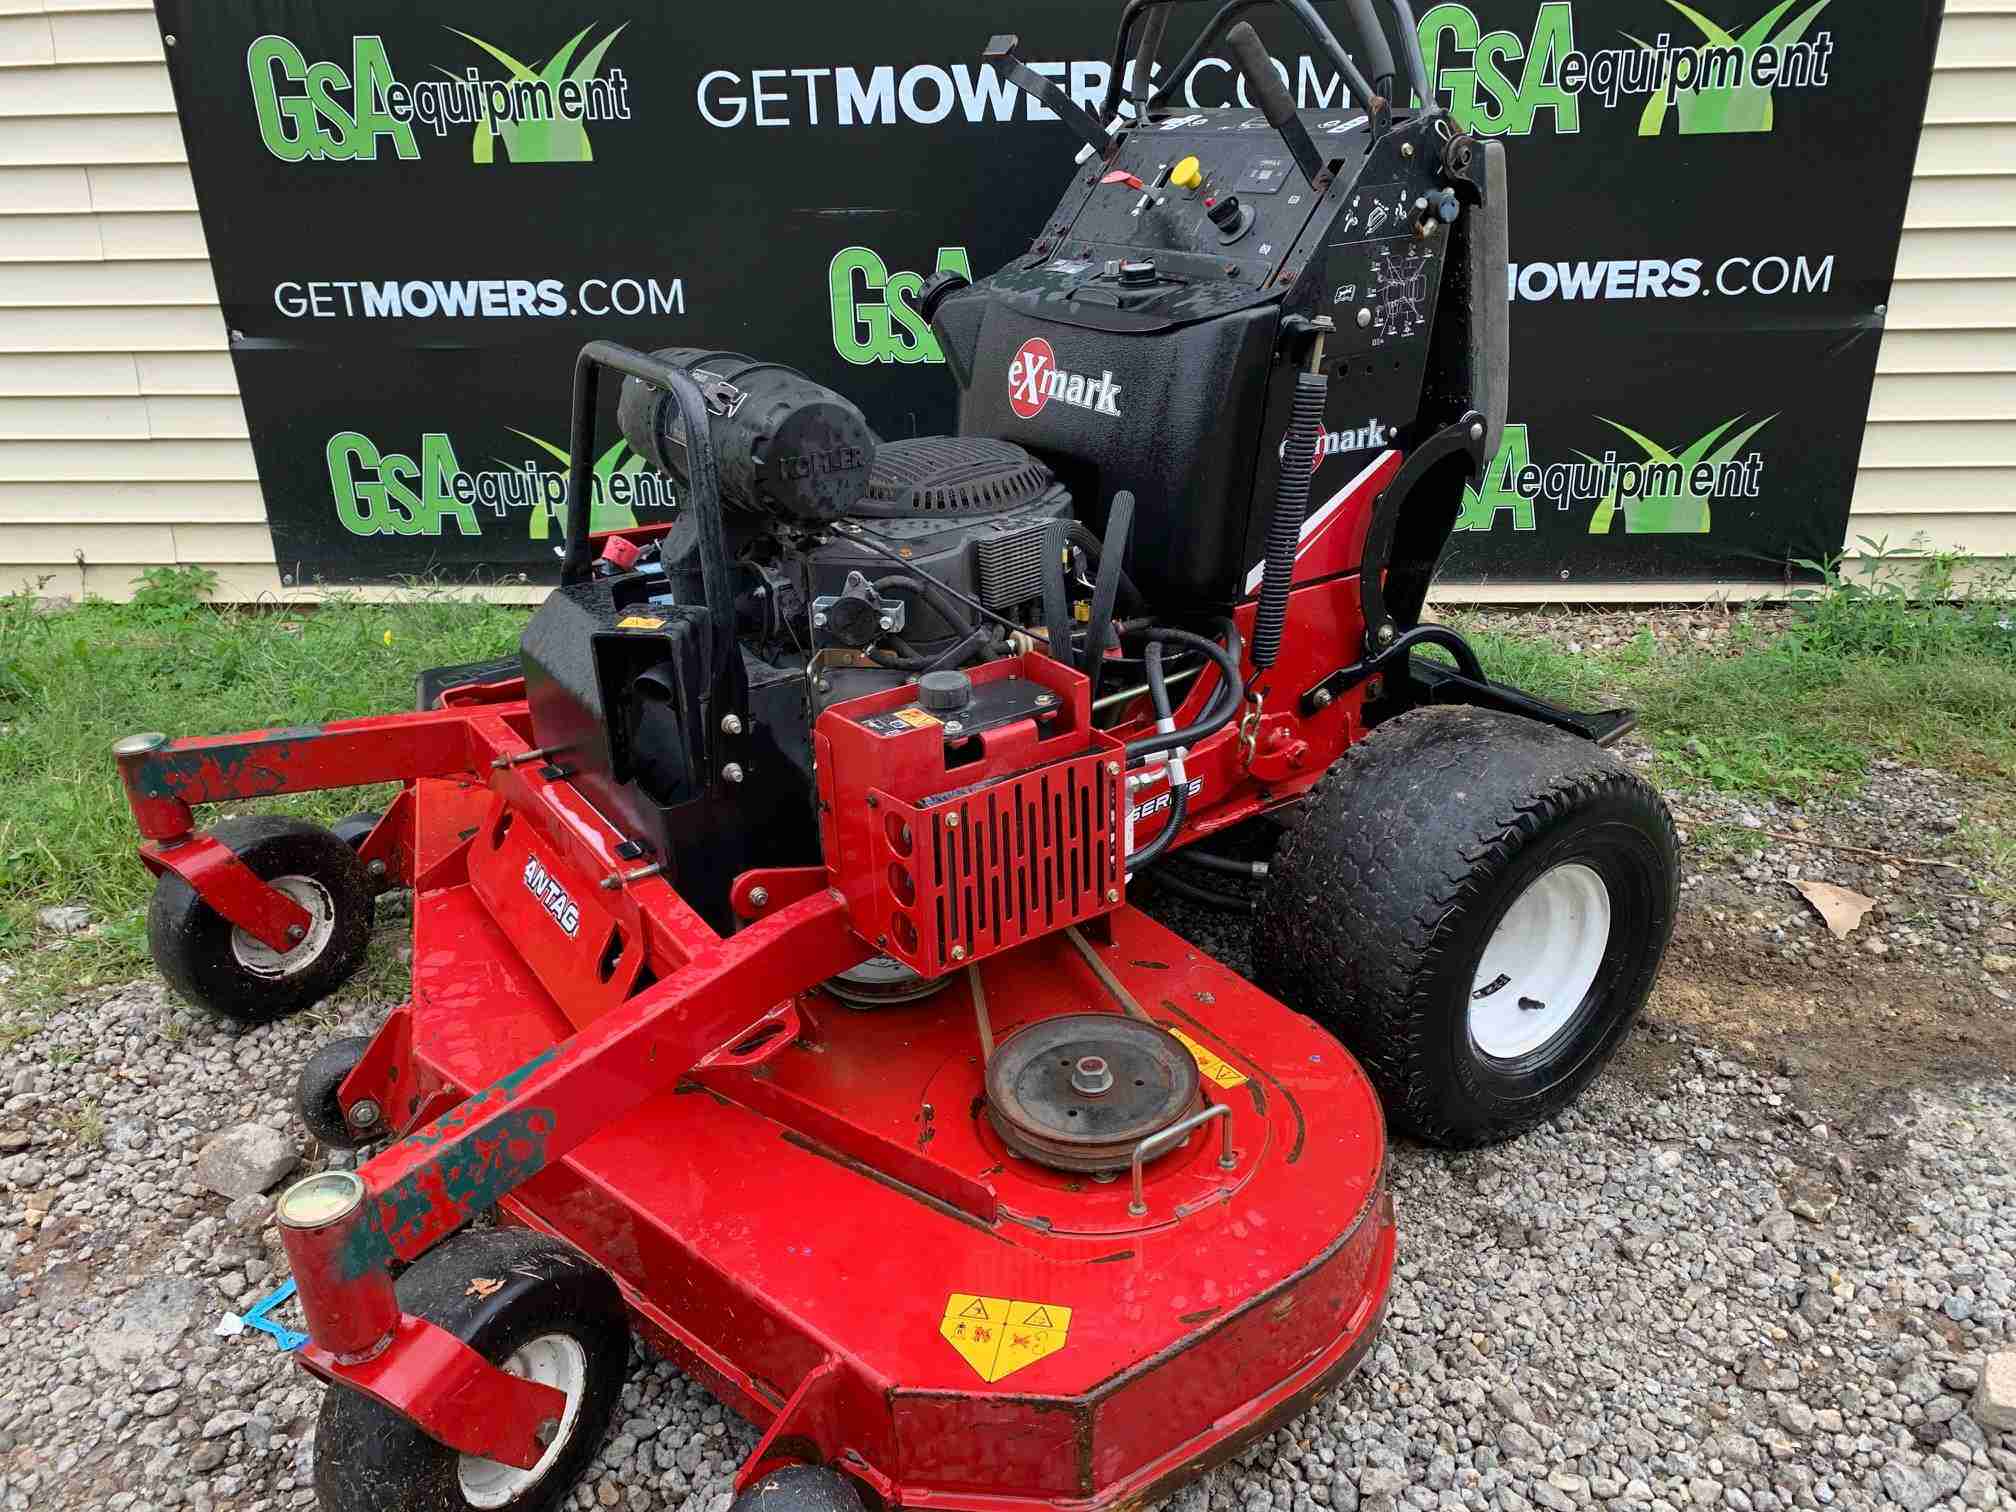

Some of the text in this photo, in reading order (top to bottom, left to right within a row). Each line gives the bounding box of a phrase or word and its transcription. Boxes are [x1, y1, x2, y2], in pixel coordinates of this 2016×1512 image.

[274, 278, 686, 318] GETMOWERS.COM
[1507, 256, 1835, 301] OWERS.COM
[451, 460, 677, 517] equipent
